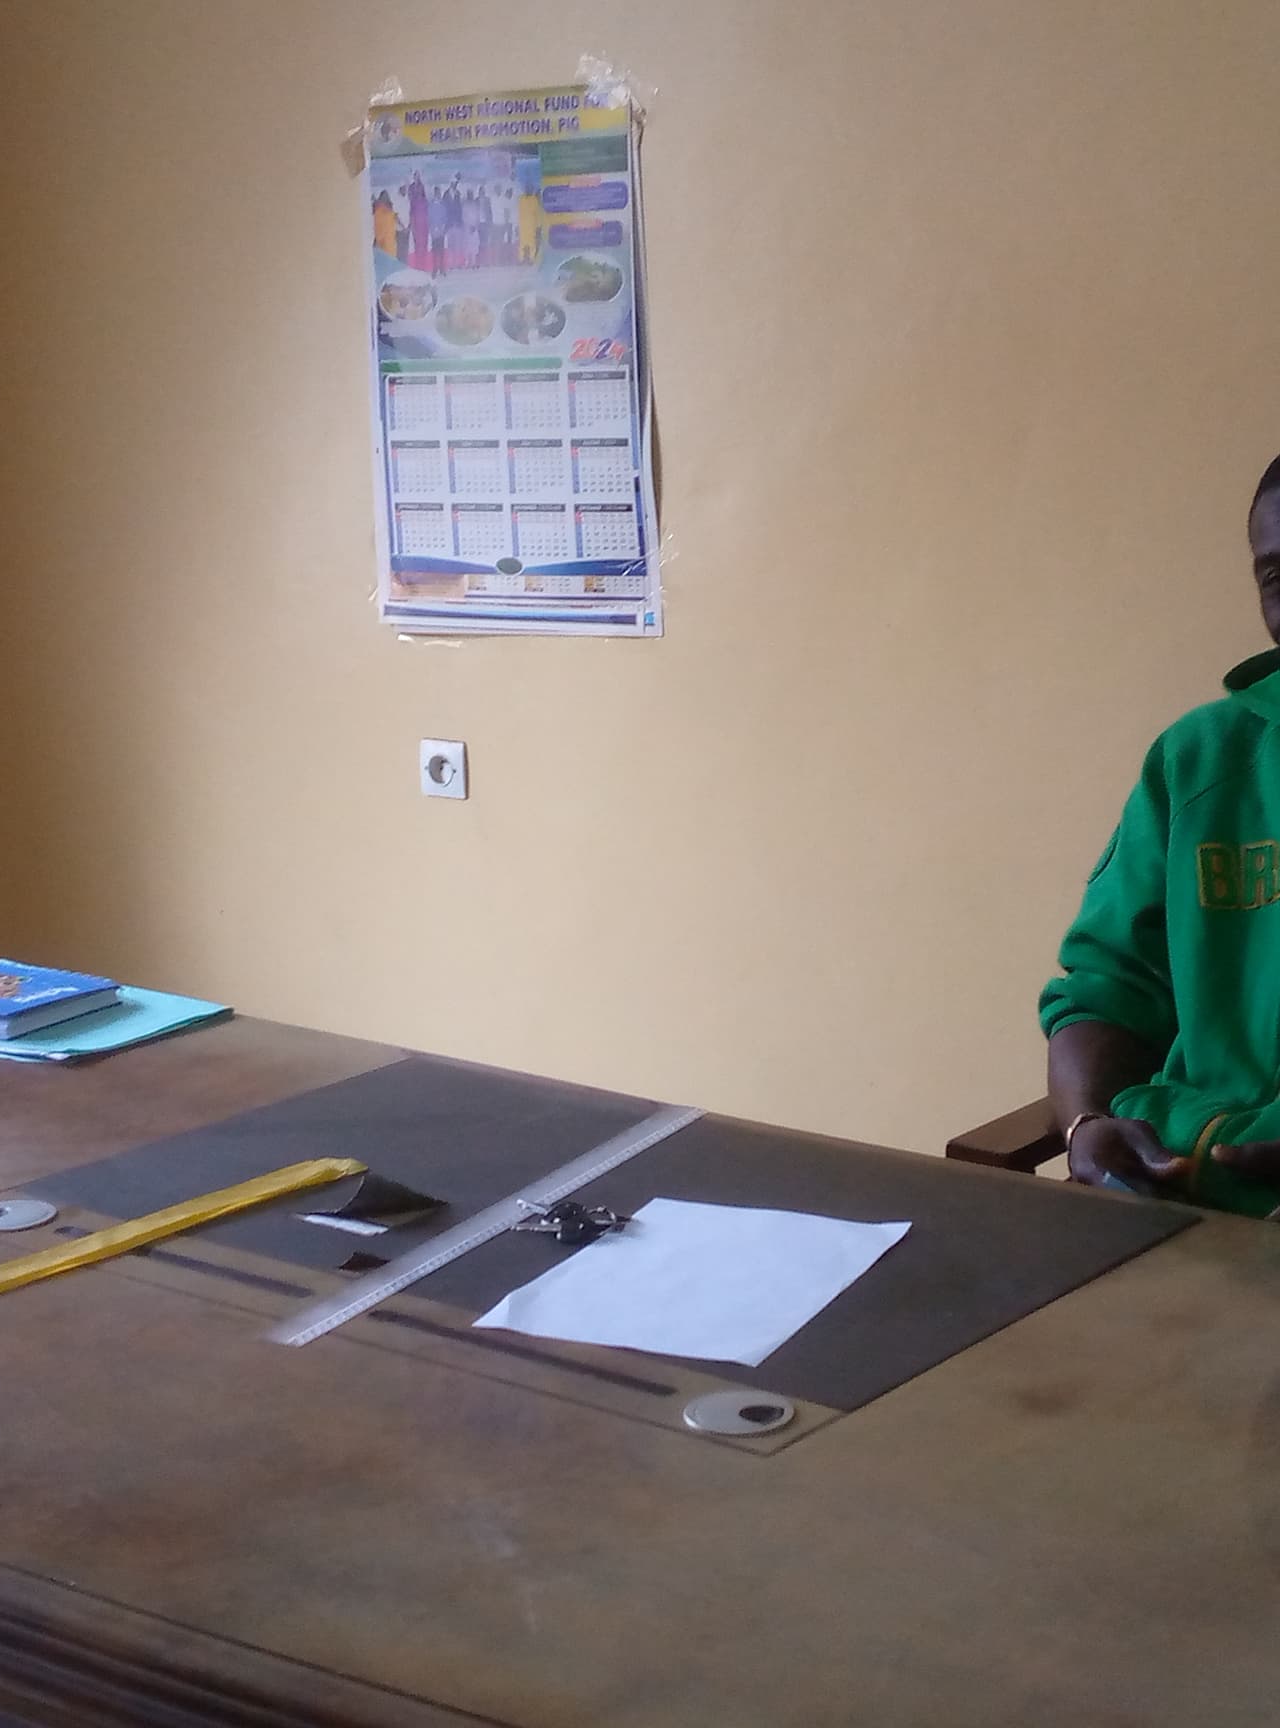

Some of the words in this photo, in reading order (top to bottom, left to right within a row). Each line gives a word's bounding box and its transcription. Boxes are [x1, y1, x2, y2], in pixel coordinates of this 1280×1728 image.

[404, 109, 441, 125] NORTH
[445, 104, 472, 121] WEST
[544, 95, 579, 112] FUND
[431, 125, 473, 143] HEALTH
